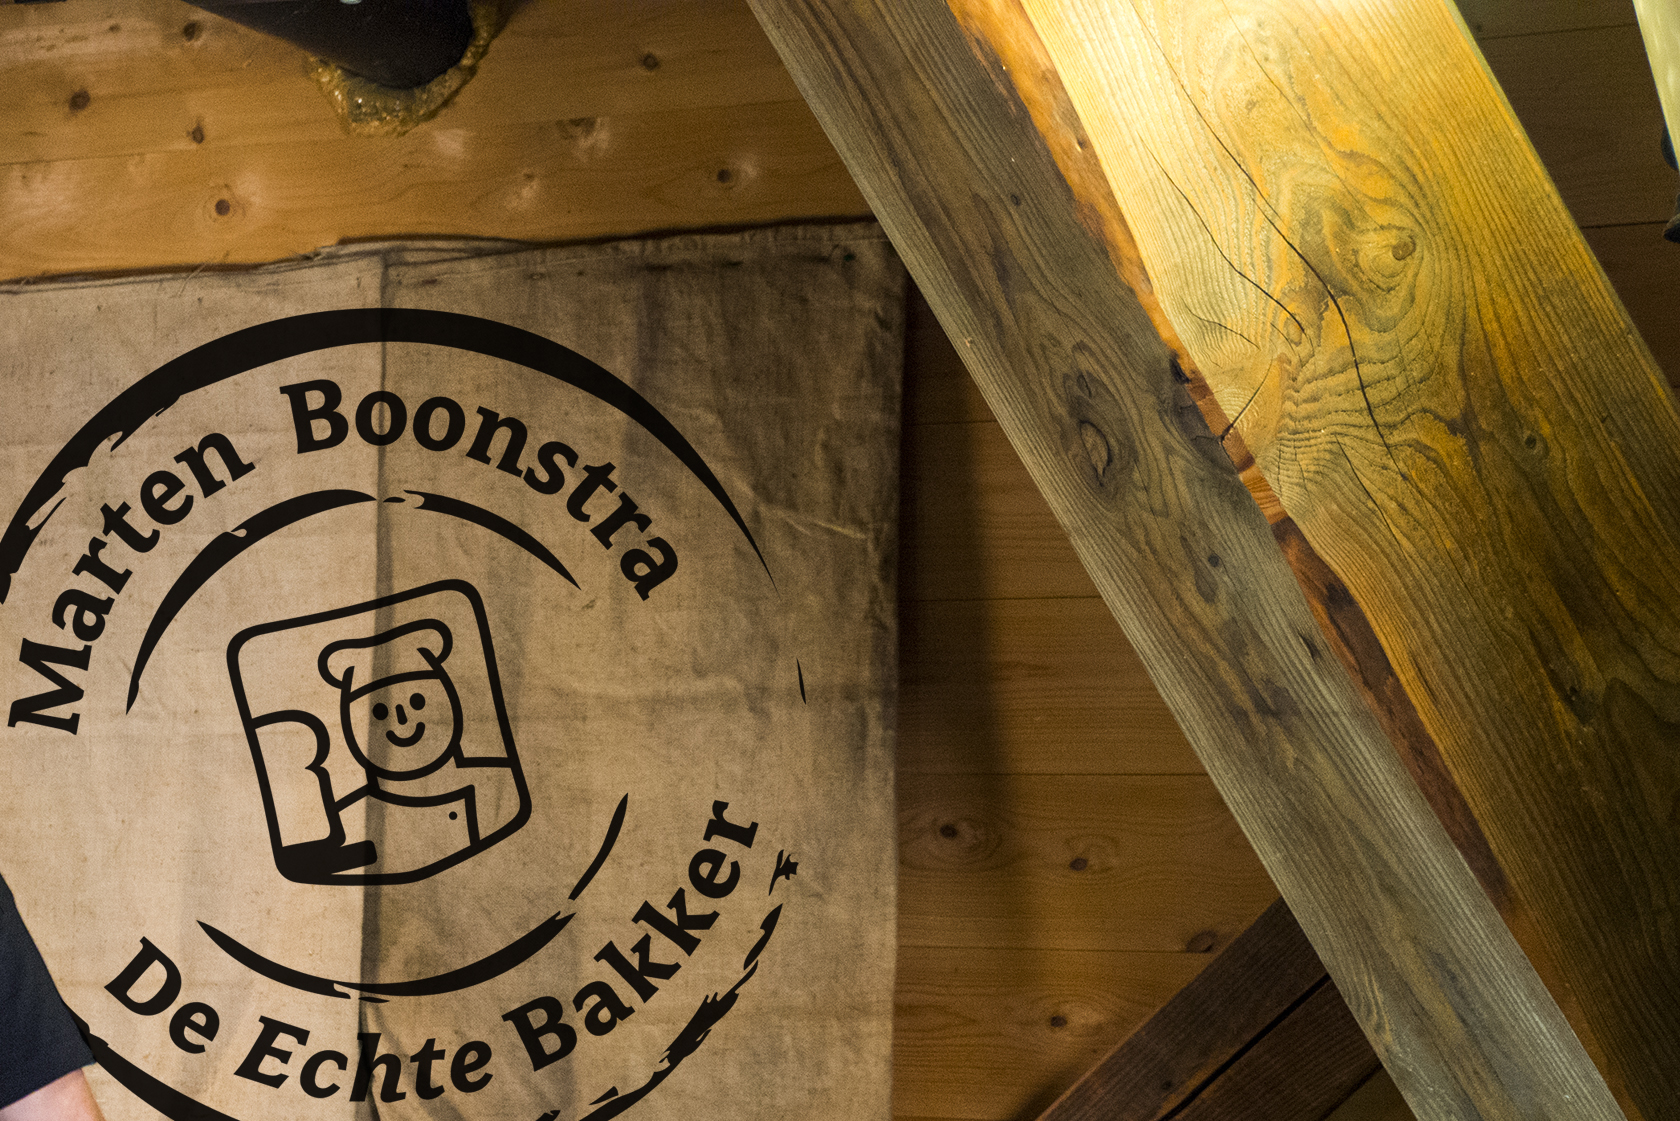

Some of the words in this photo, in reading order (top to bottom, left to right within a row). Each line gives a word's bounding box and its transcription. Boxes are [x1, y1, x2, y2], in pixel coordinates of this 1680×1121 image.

[7, 432, 255, 736] Marten
[279, 377, 680, 599] Boonstra
[104, 937, 221, 1054] De
[234, 1016, 493, 1103] Echte
[501, 799, 760, 1073] Bakker
